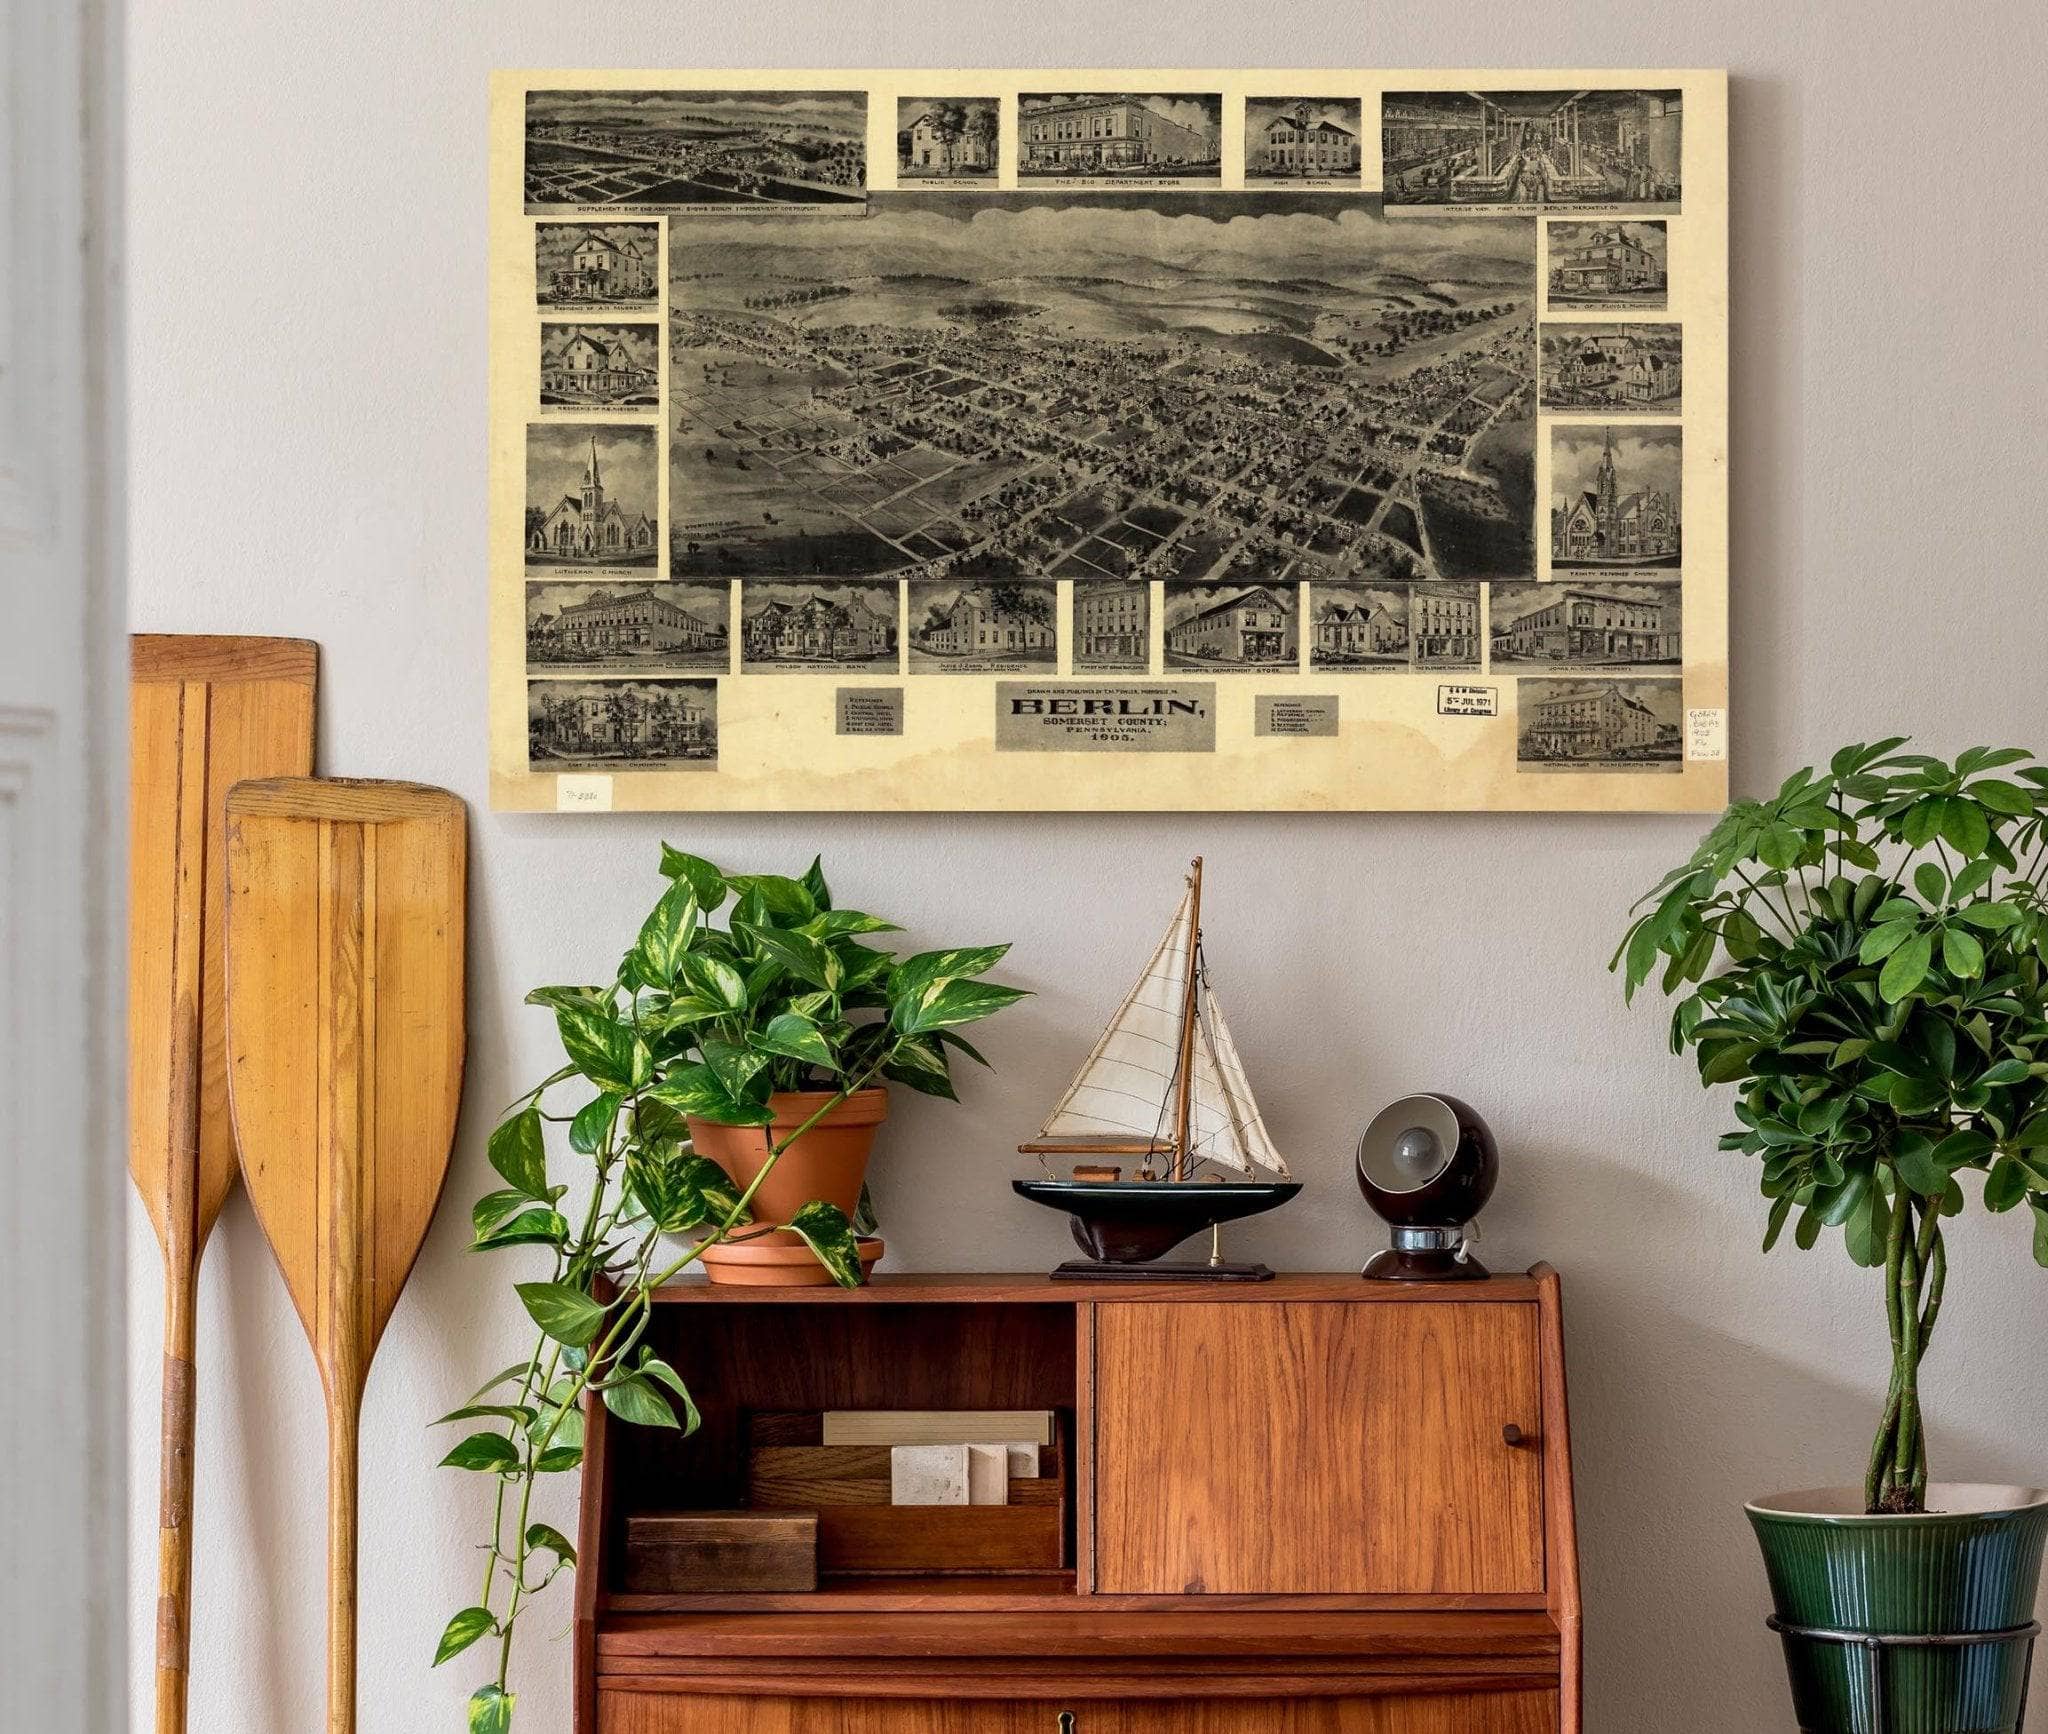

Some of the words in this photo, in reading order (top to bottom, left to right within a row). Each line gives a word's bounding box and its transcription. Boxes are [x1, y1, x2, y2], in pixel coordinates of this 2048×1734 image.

[1461, 697, 1475, 706] JUL
[1476, 698, 1491, 706] 1971
[1010, 698, 1206, 719] BERLIN,
[1043, 718, 1109, 726] SOMERSET
